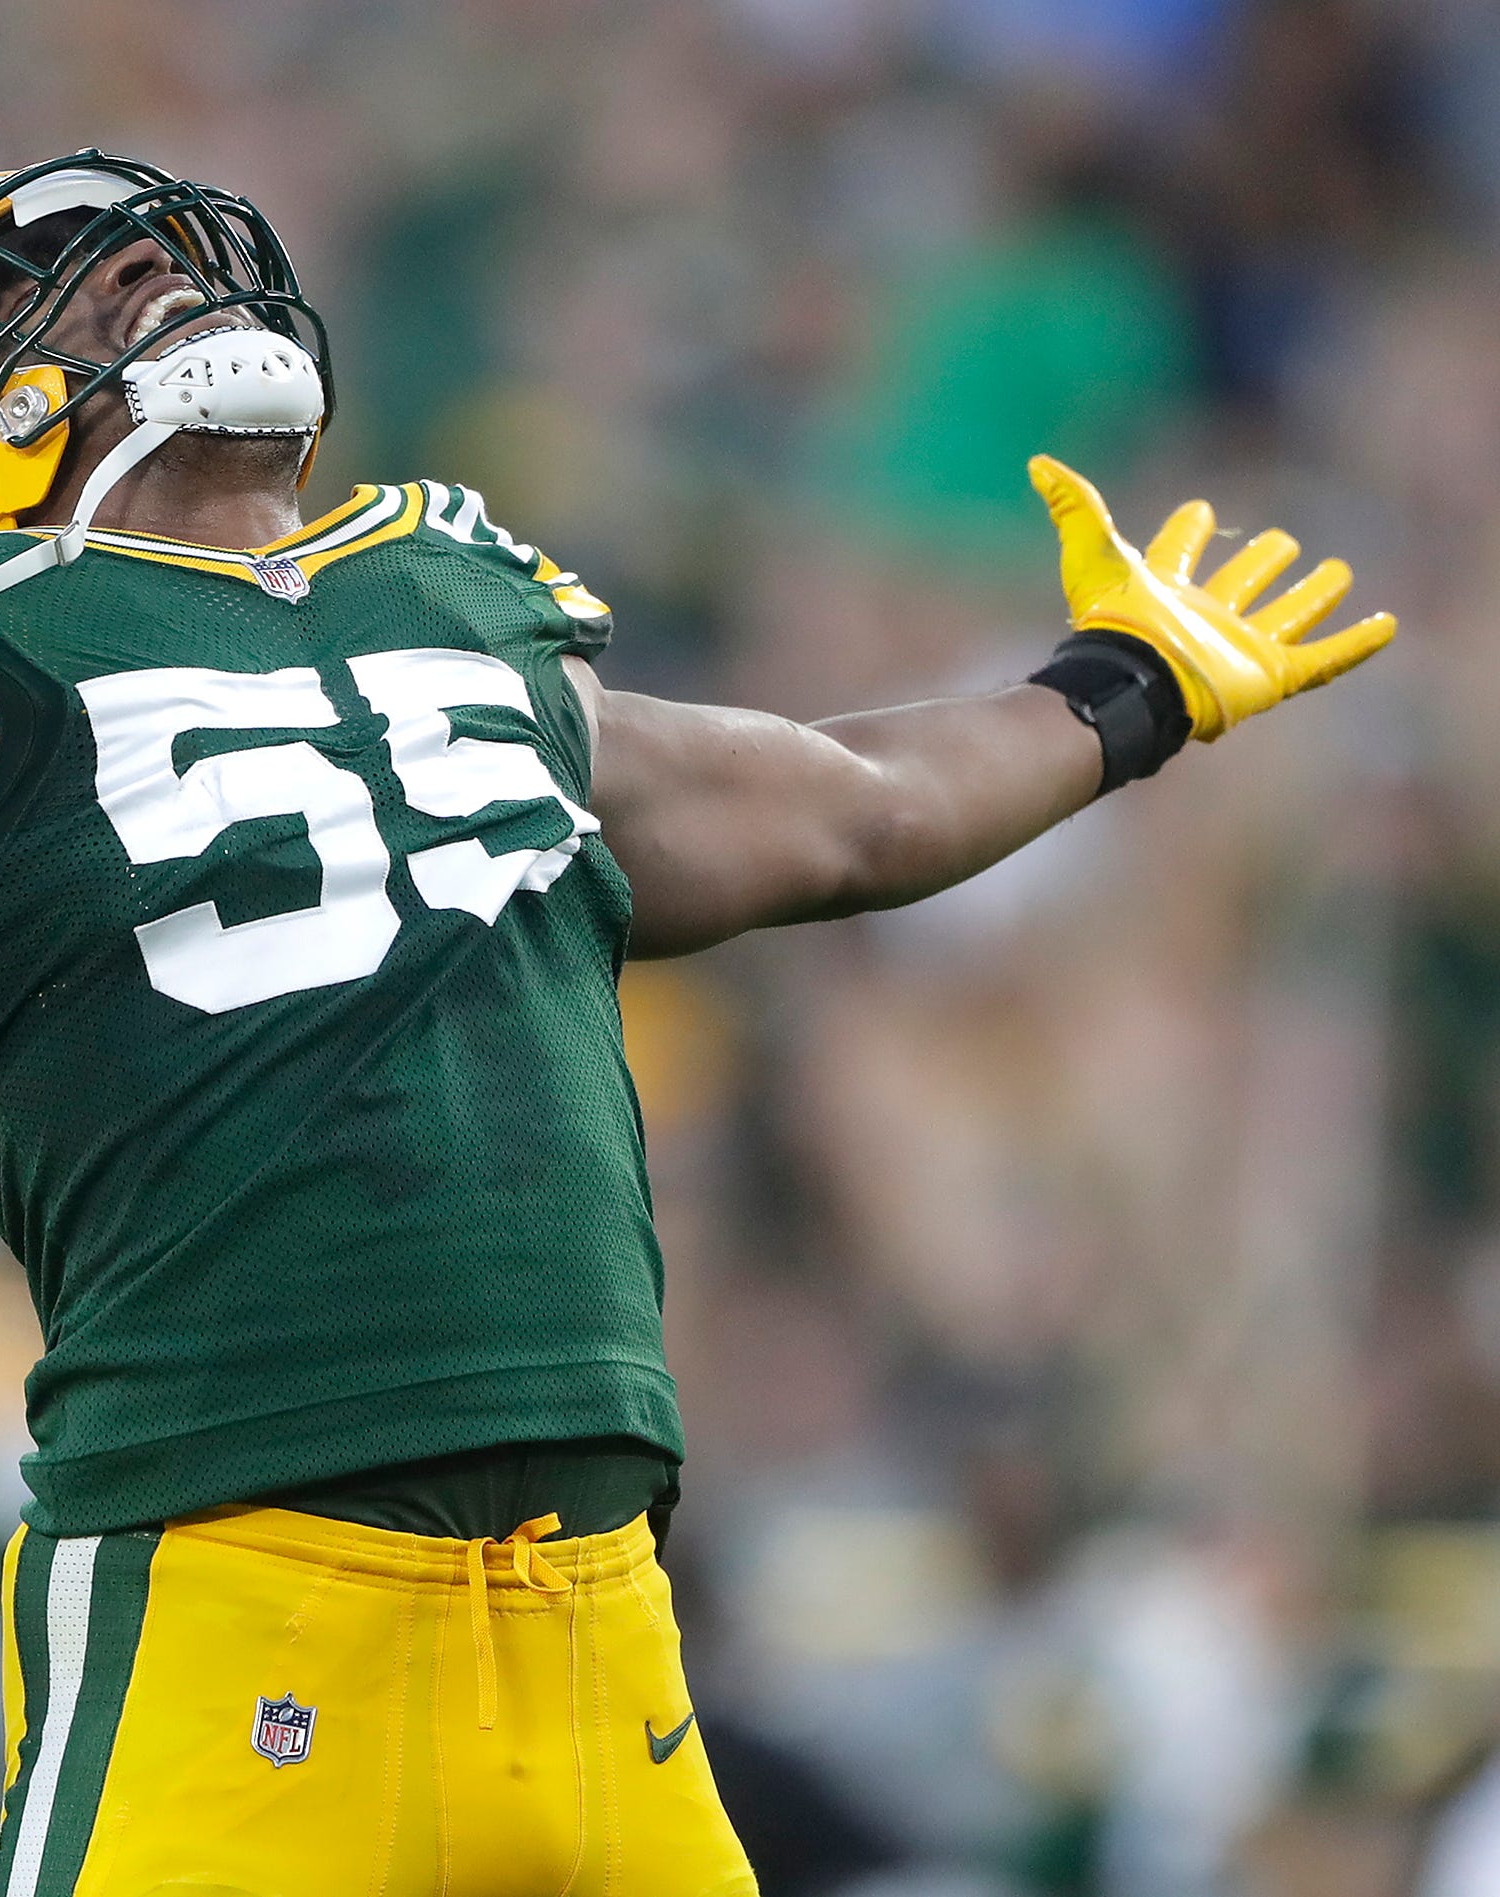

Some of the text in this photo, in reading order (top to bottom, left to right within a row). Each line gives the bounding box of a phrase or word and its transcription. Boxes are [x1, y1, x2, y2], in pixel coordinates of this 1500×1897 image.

[262, 569, 302, 592] NFL
[75, 647, 602, 1016] 55
[261, 1722, 302, 1755] NFL
